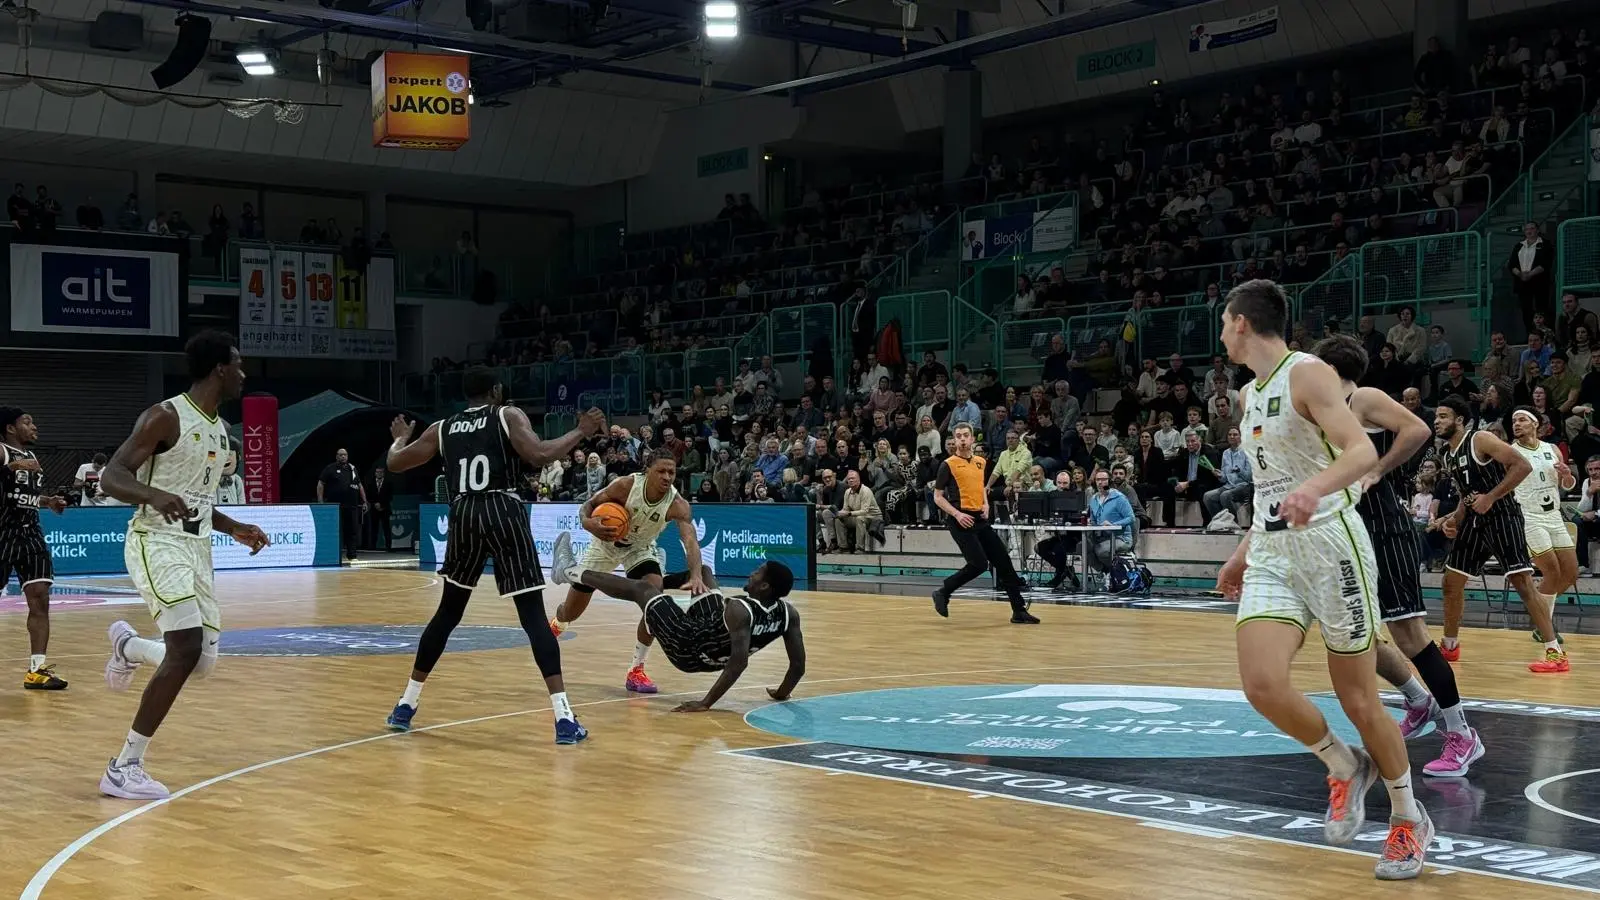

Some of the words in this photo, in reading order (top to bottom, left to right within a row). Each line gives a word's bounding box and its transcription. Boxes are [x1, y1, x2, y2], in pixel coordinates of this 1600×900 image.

[1088, 50, 1133, 73] BLOCK
[388, 76, 442, 87] expert
[389, 94, 466, 116] JAKOB
[993, 229, 1020, 246] Block
[61, 267, 132, 303] ait
[249, 269, 264, 298] 4
[281, 270, 297, 300] 5
[306, 273, 333, 302] 13
[339, 274, 361, 302] 11
[242, 331, 303, 343] engelhardt
[1256, 446, 1267, 470] 6
[203, 466, 211, 485] 8
[459, 454, 490, 493] 10
[1539, 471, 1546, 482] 0
[556, 515, 573, 529] IHRE
[44, 530, 125, 544] dikamente
[722, 529, 793, 545] Medikamente
[51, 545, 87, 558] Klick
[722, 547, 740, 561] per
[741, 545, 767, 560] Klick
[1338, 559, 1358, 598] Weisse
[936, 711, 1091, 725] Klick
[1096, 716, 1227, 728] per
[811, 750, 1326, 830] ALKOHOLFREI
